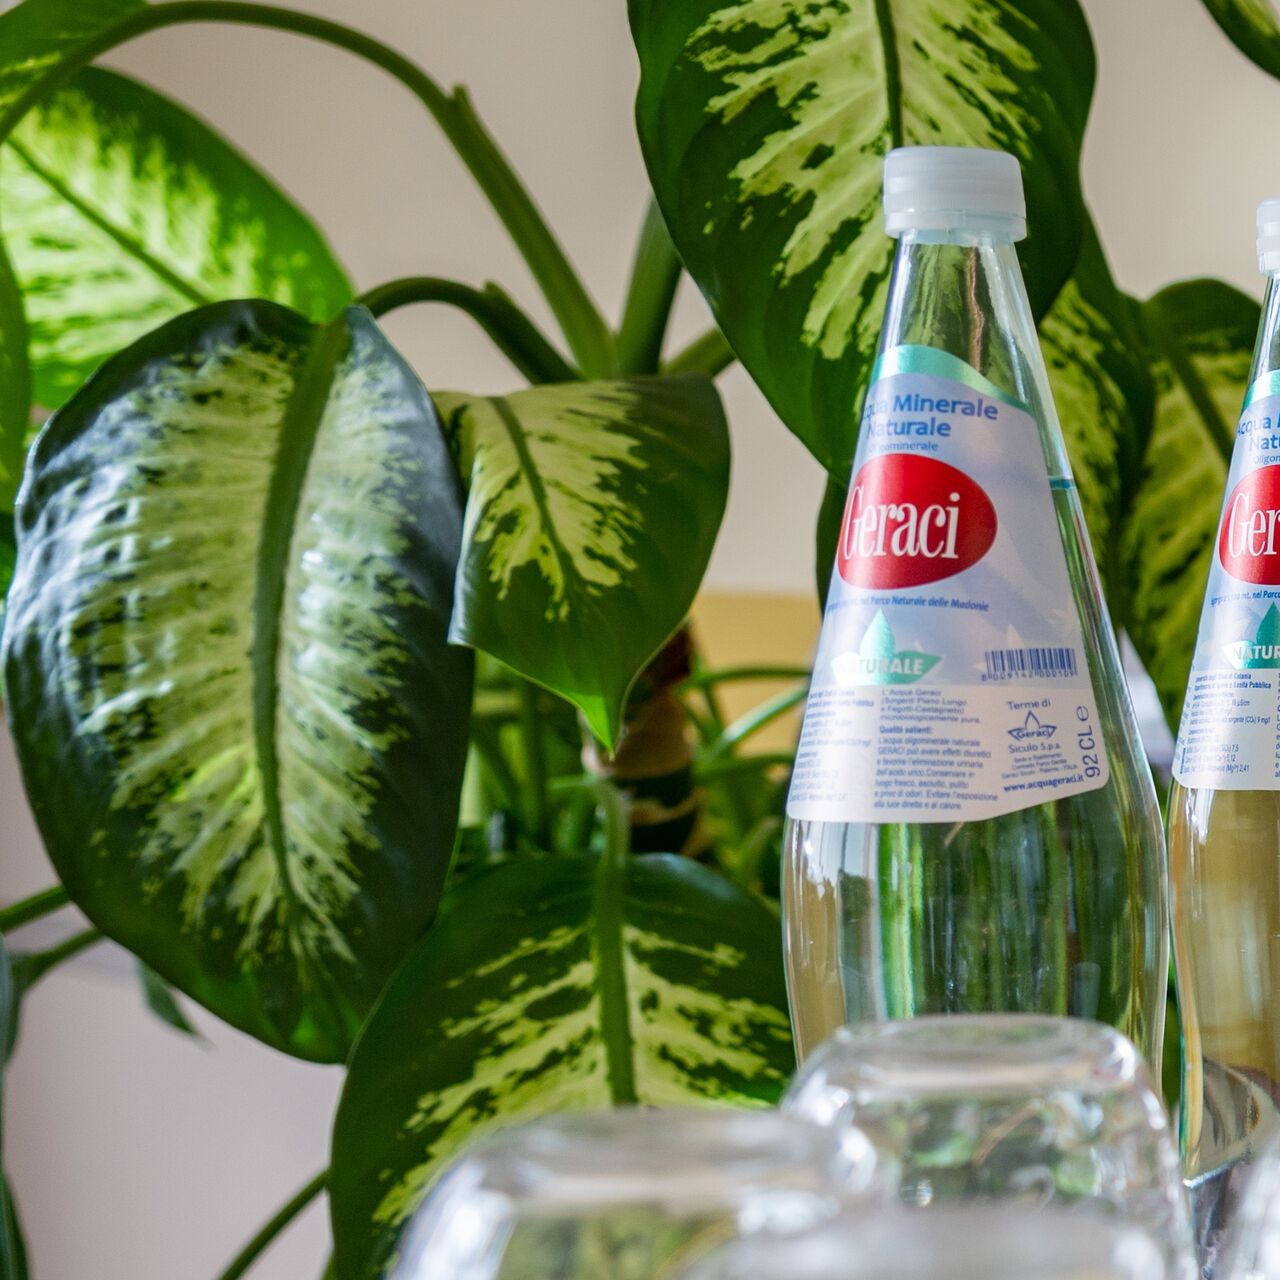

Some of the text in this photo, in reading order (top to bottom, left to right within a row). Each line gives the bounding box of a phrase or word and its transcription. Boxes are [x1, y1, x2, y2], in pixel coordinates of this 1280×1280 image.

[893, 394, 998, 420] Minerale
[843, 485, 960, 560] Geraci
[1007, 700, 1040, 710] Terme
[1077, 724, 1095, 751] CL
[1082, 754, 1101, 778] 92
